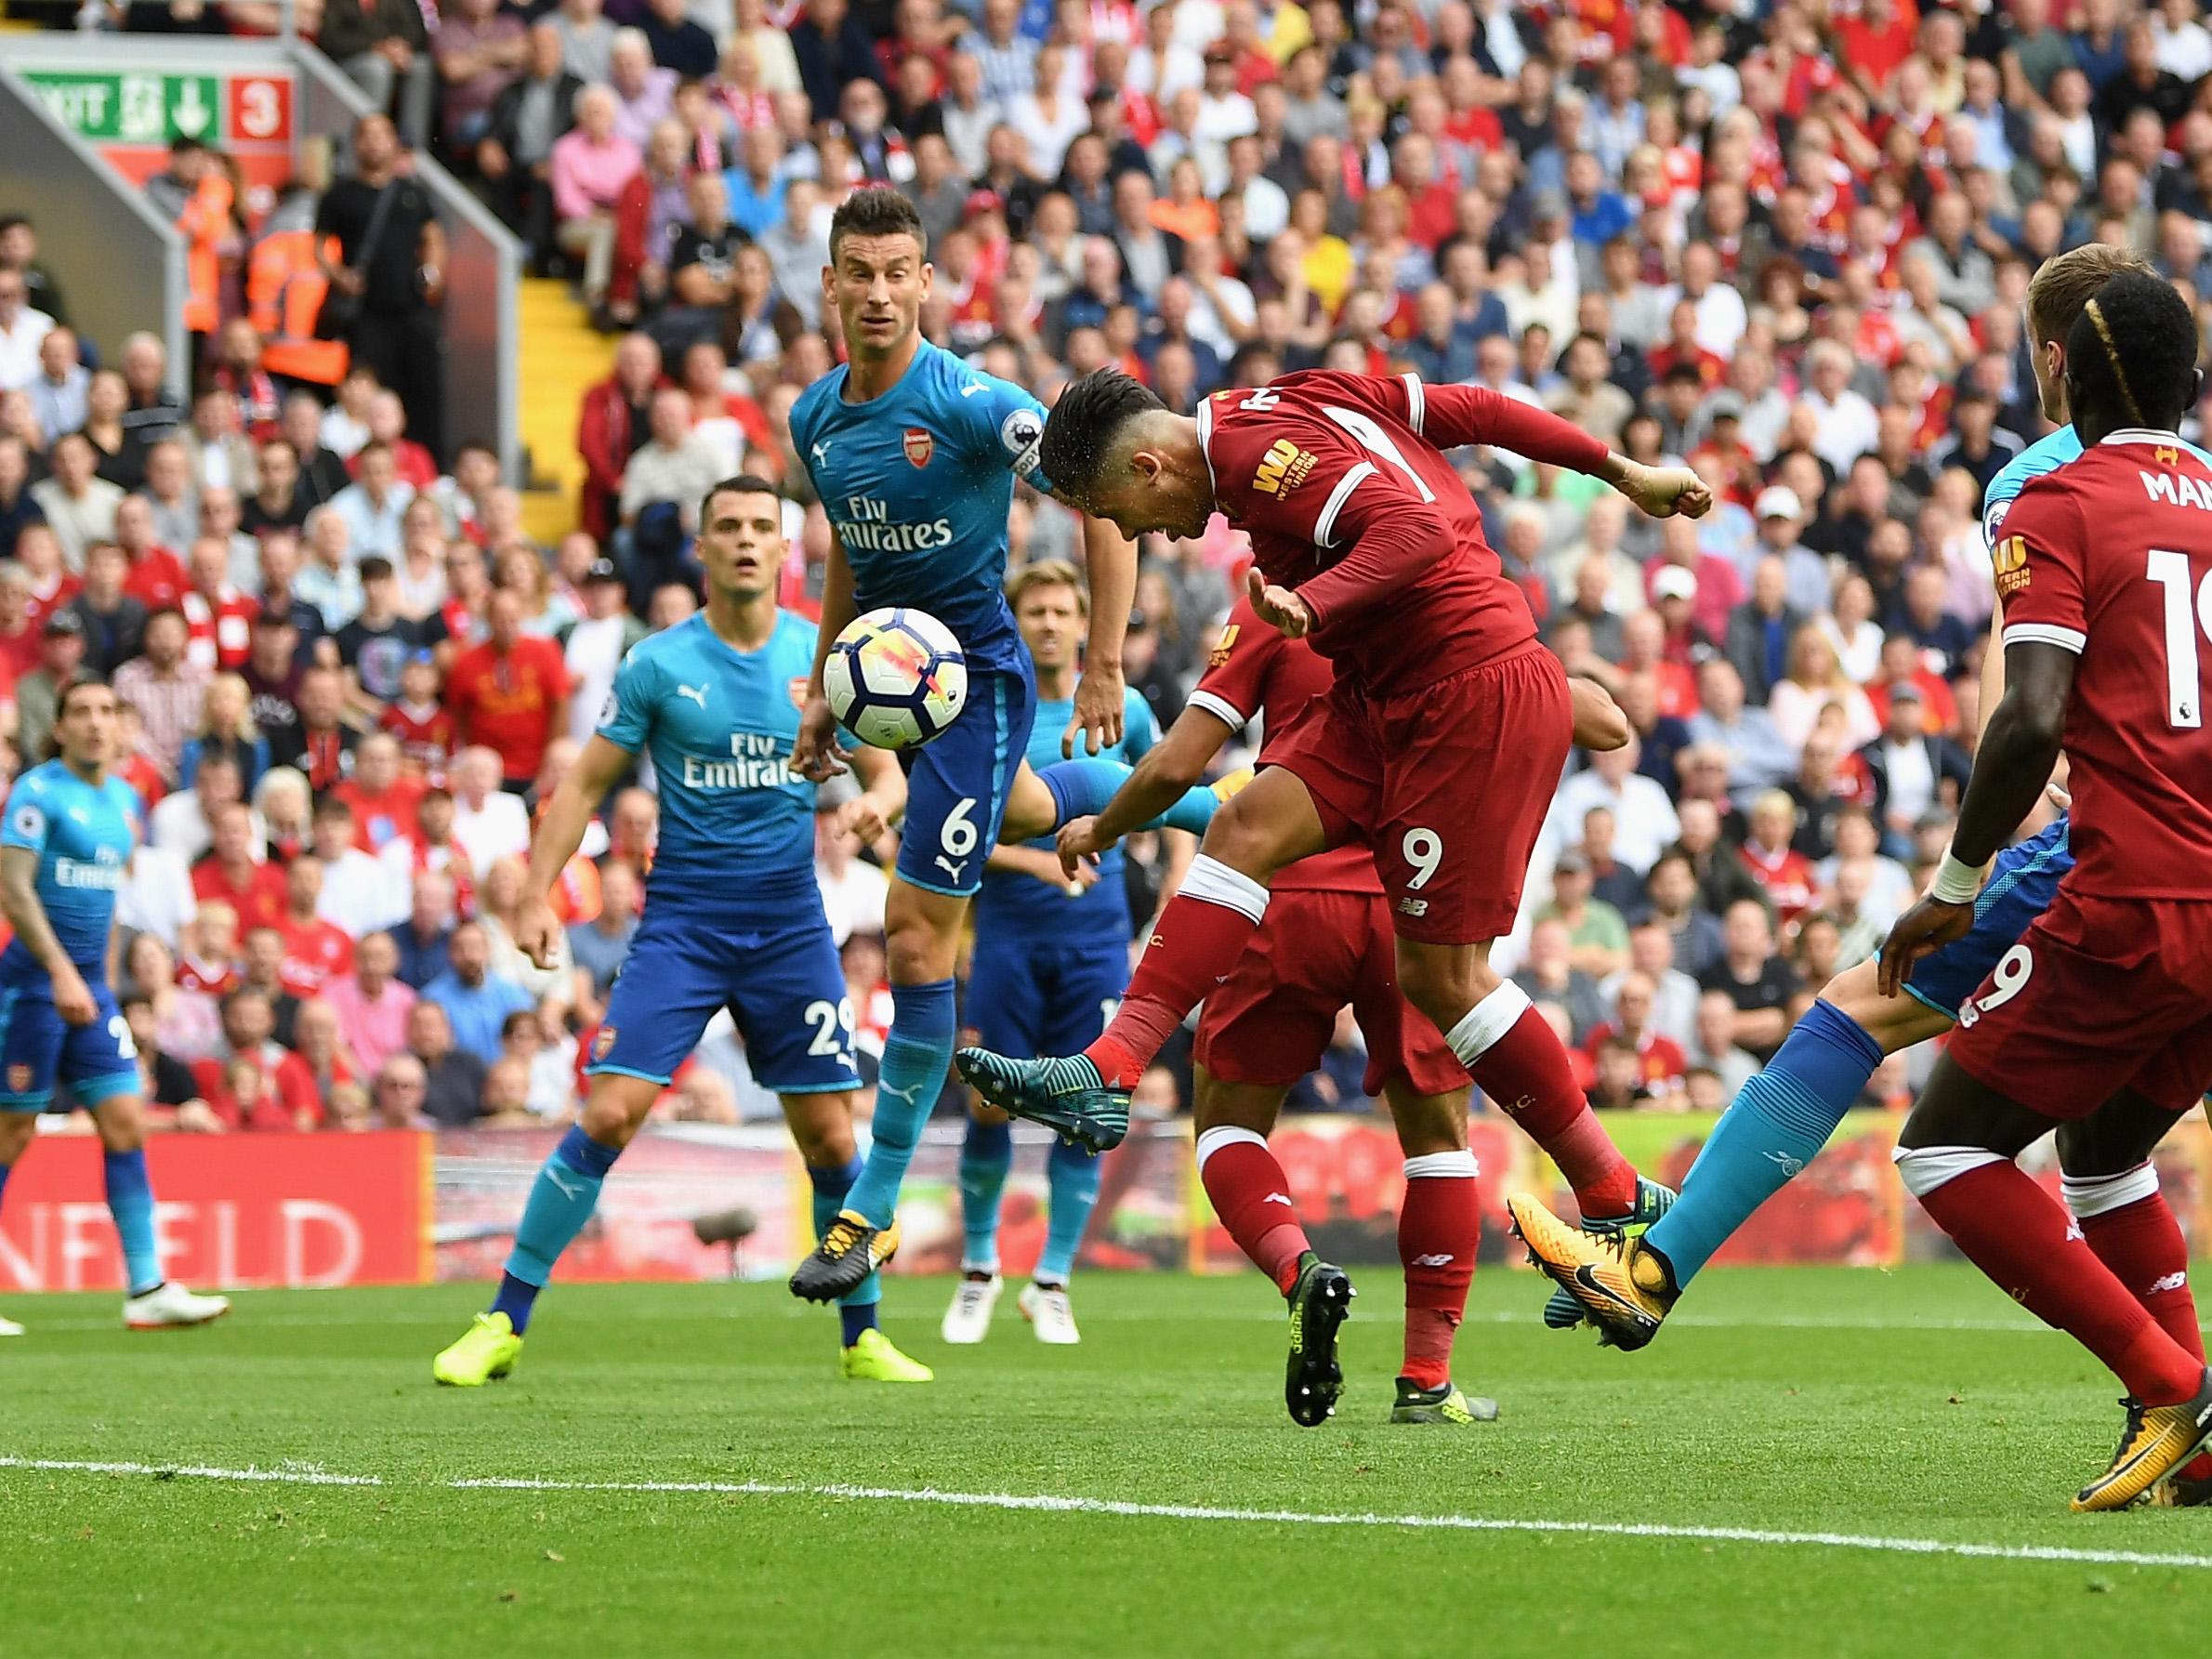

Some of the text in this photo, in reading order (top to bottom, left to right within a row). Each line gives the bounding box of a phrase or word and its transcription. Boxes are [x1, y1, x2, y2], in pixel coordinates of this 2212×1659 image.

[240, 80, 282, 138] 3
[1252, 438, 1299, 494] WU
[1276, 450, 1310, 501] WESTERN
[1291, 454, 1319, 488] UNION
[837, 518, 953, 552] mirates
[848, 495, 887, 523] Fly
[730, 732, 777, 757] Fly
[940, 797, 978, 856] 6
[1402, 827, 1442, 890] 9
[804, 996, 857, 1056] 29
